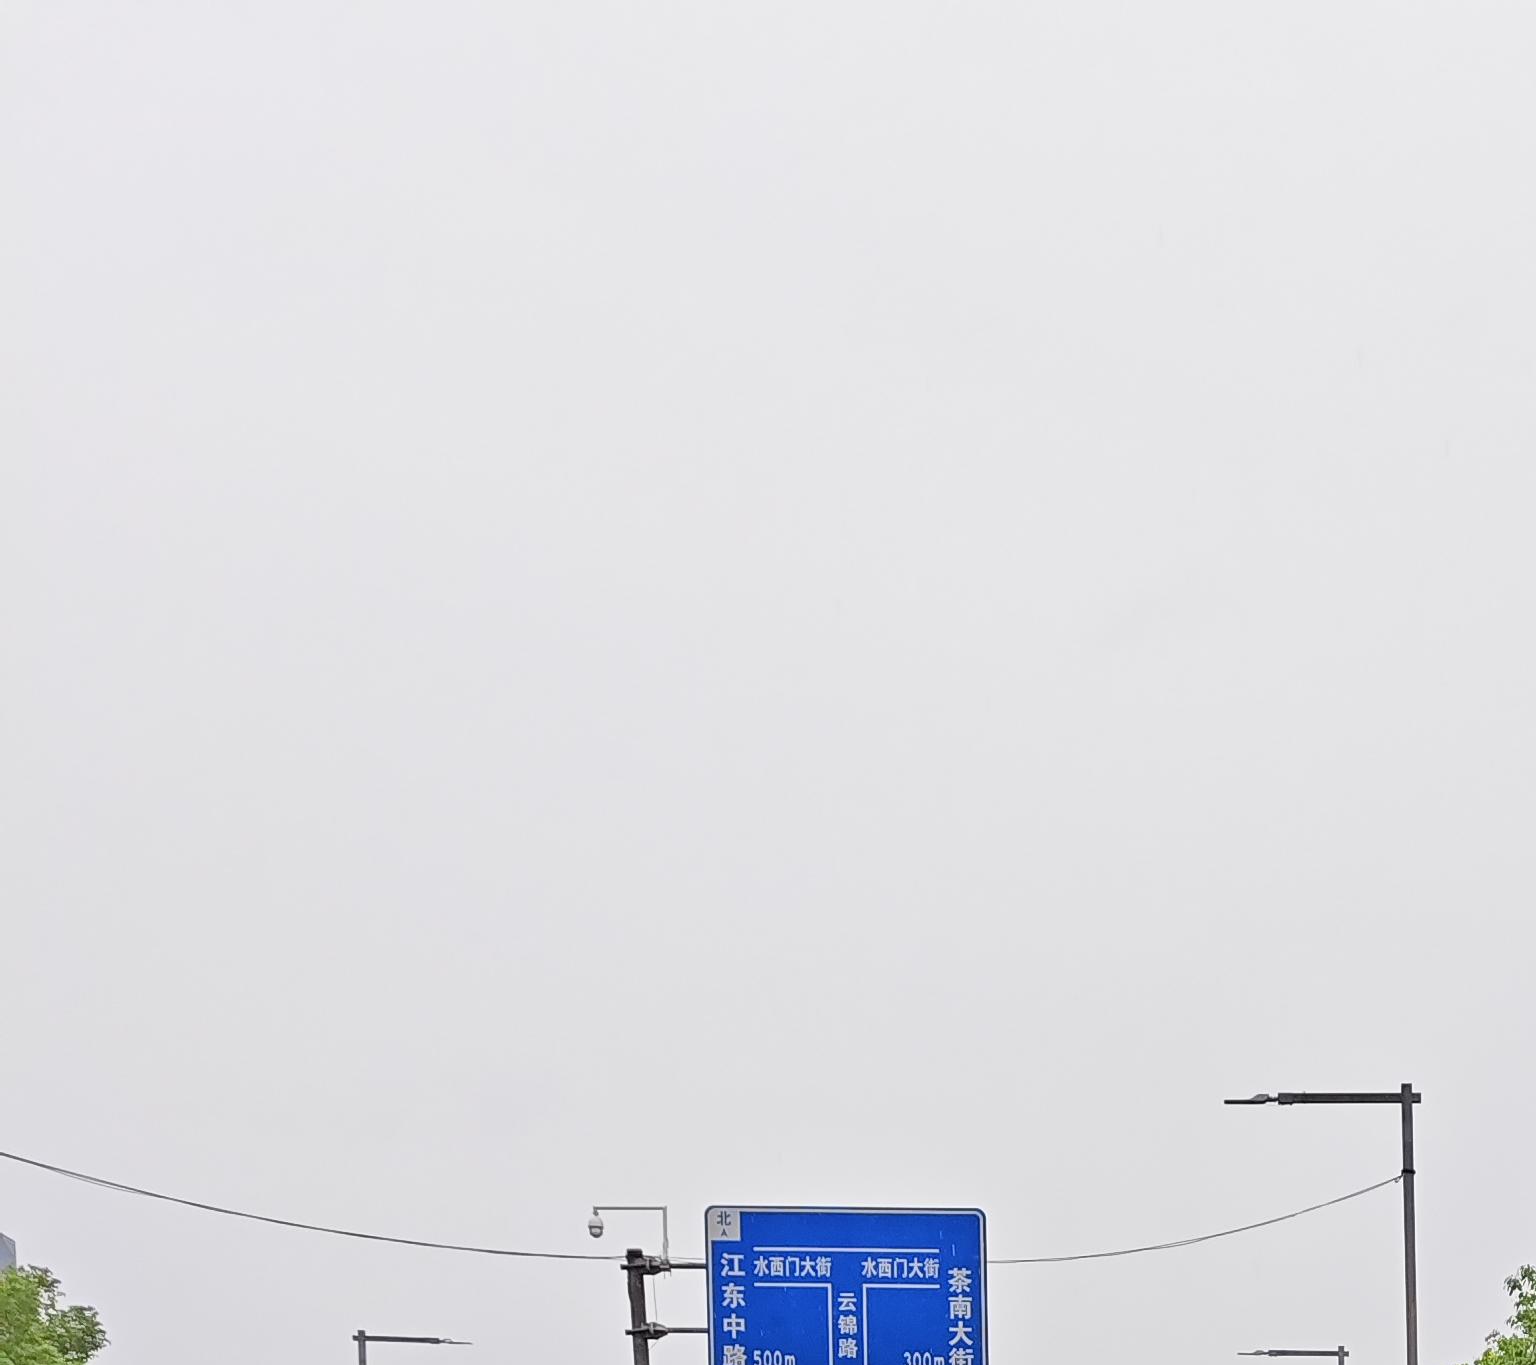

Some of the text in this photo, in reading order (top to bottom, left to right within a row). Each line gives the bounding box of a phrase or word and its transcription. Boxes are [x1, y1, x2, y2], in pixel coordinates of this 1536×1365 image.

[716, 1211, 731, 1226] 北
[753, 1256, 832, 1278] 水西门大街
[861, 1257, 939, 1279] 水西门大街
[838, 1292, 858, 1359] 云锦路
